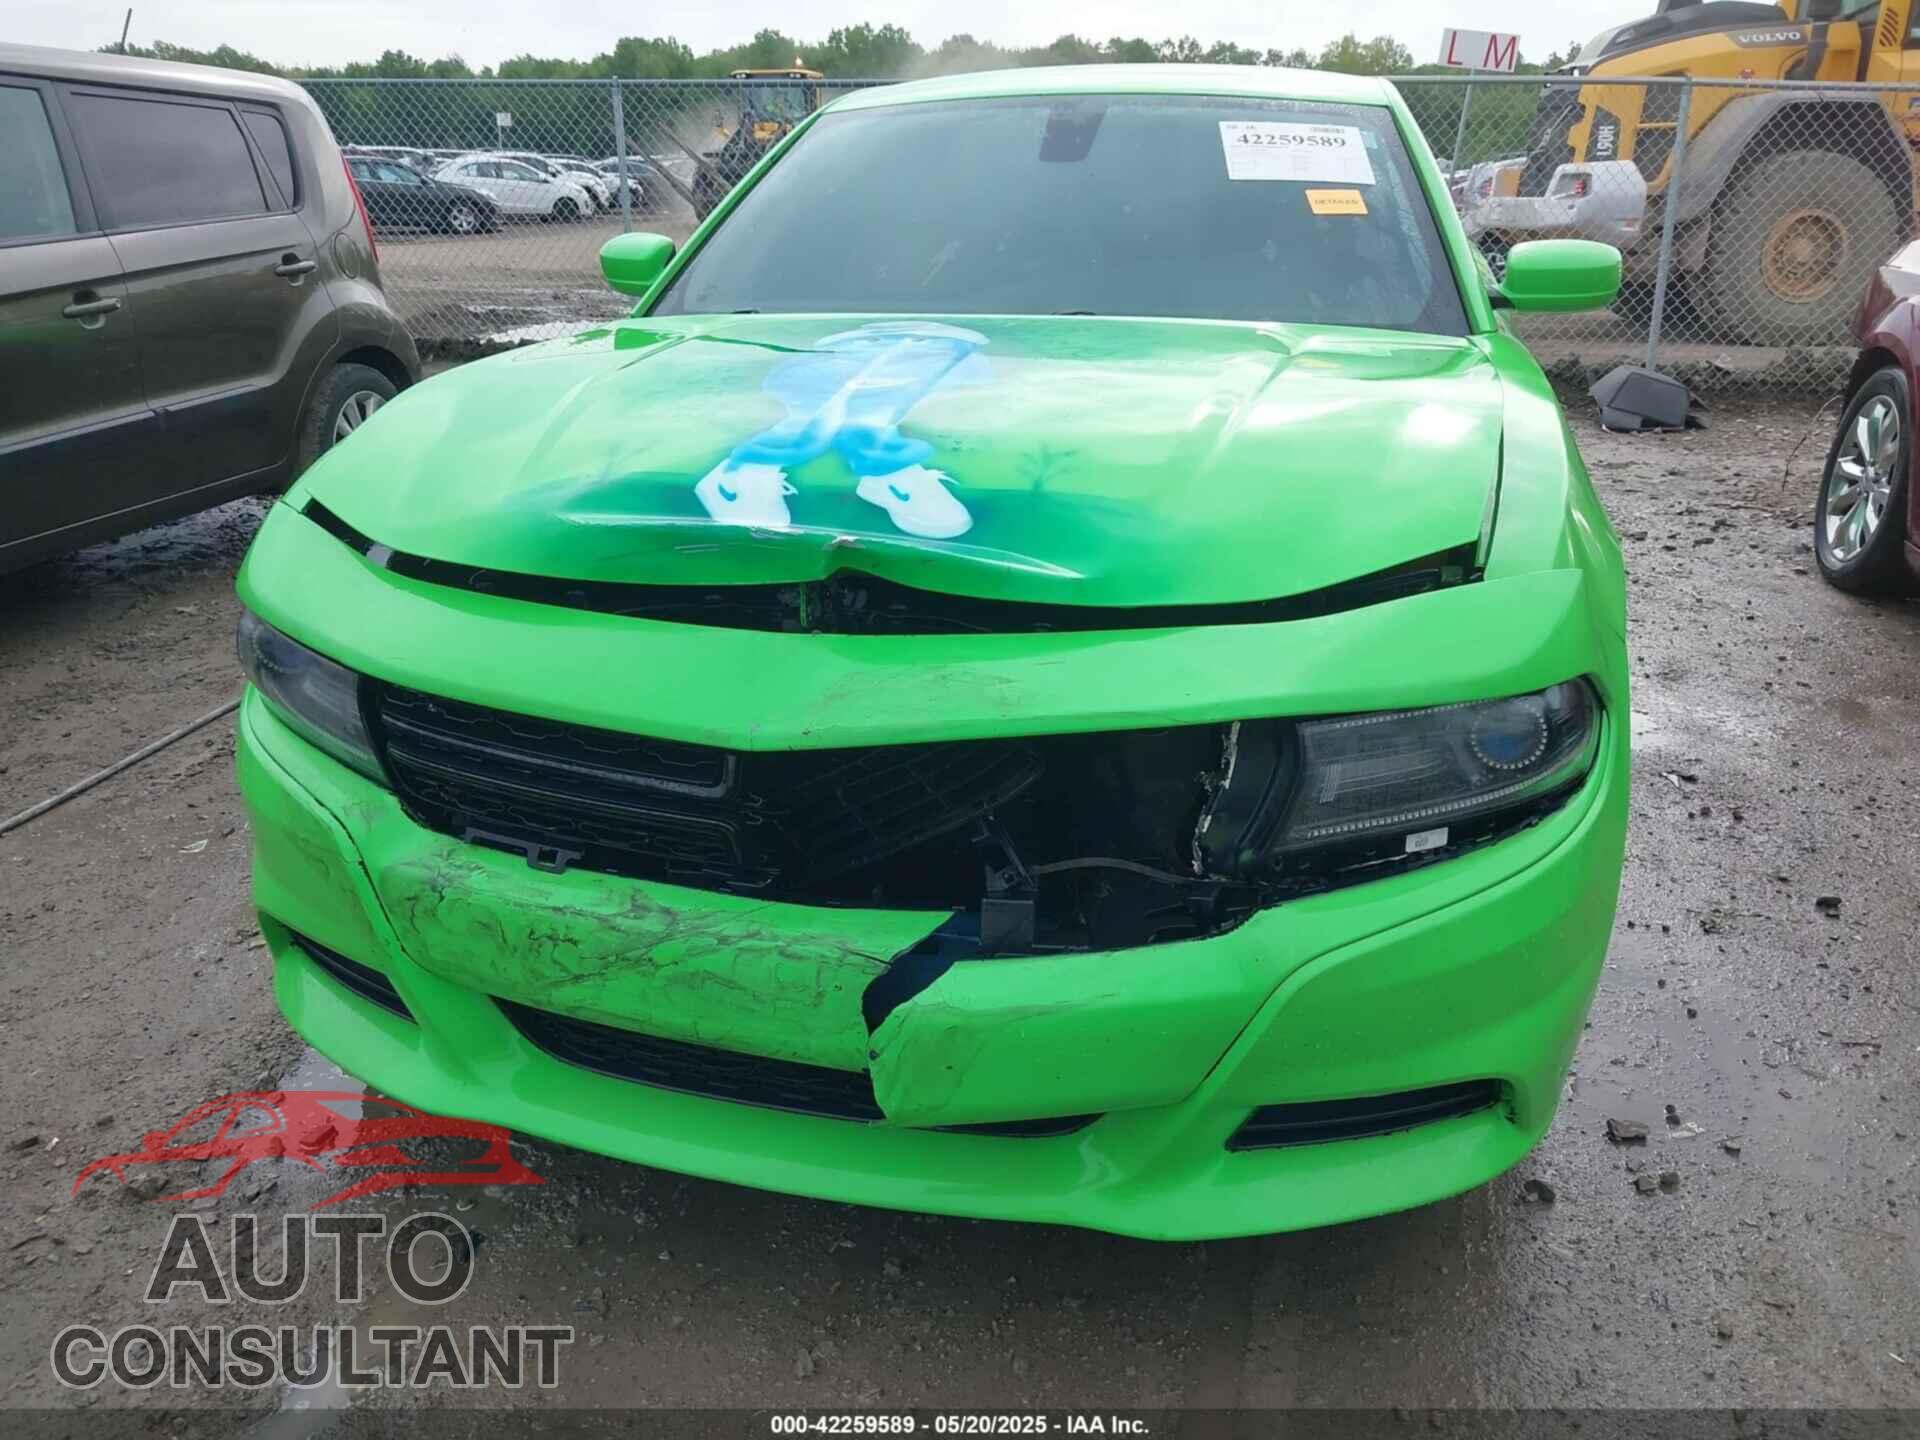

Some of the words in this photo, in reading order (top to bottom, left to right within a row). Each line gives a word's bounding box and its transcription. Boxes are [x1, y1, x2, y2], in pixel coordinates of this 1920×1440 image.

[1738, 31, 1801, 42] VOLVO
[1447, 30, 1463, 65] L
[1482, 33, 1517, 70] M
[1236, 133, 1346, 147] 42259589
[1596, 125, 1615, 156] L90H
